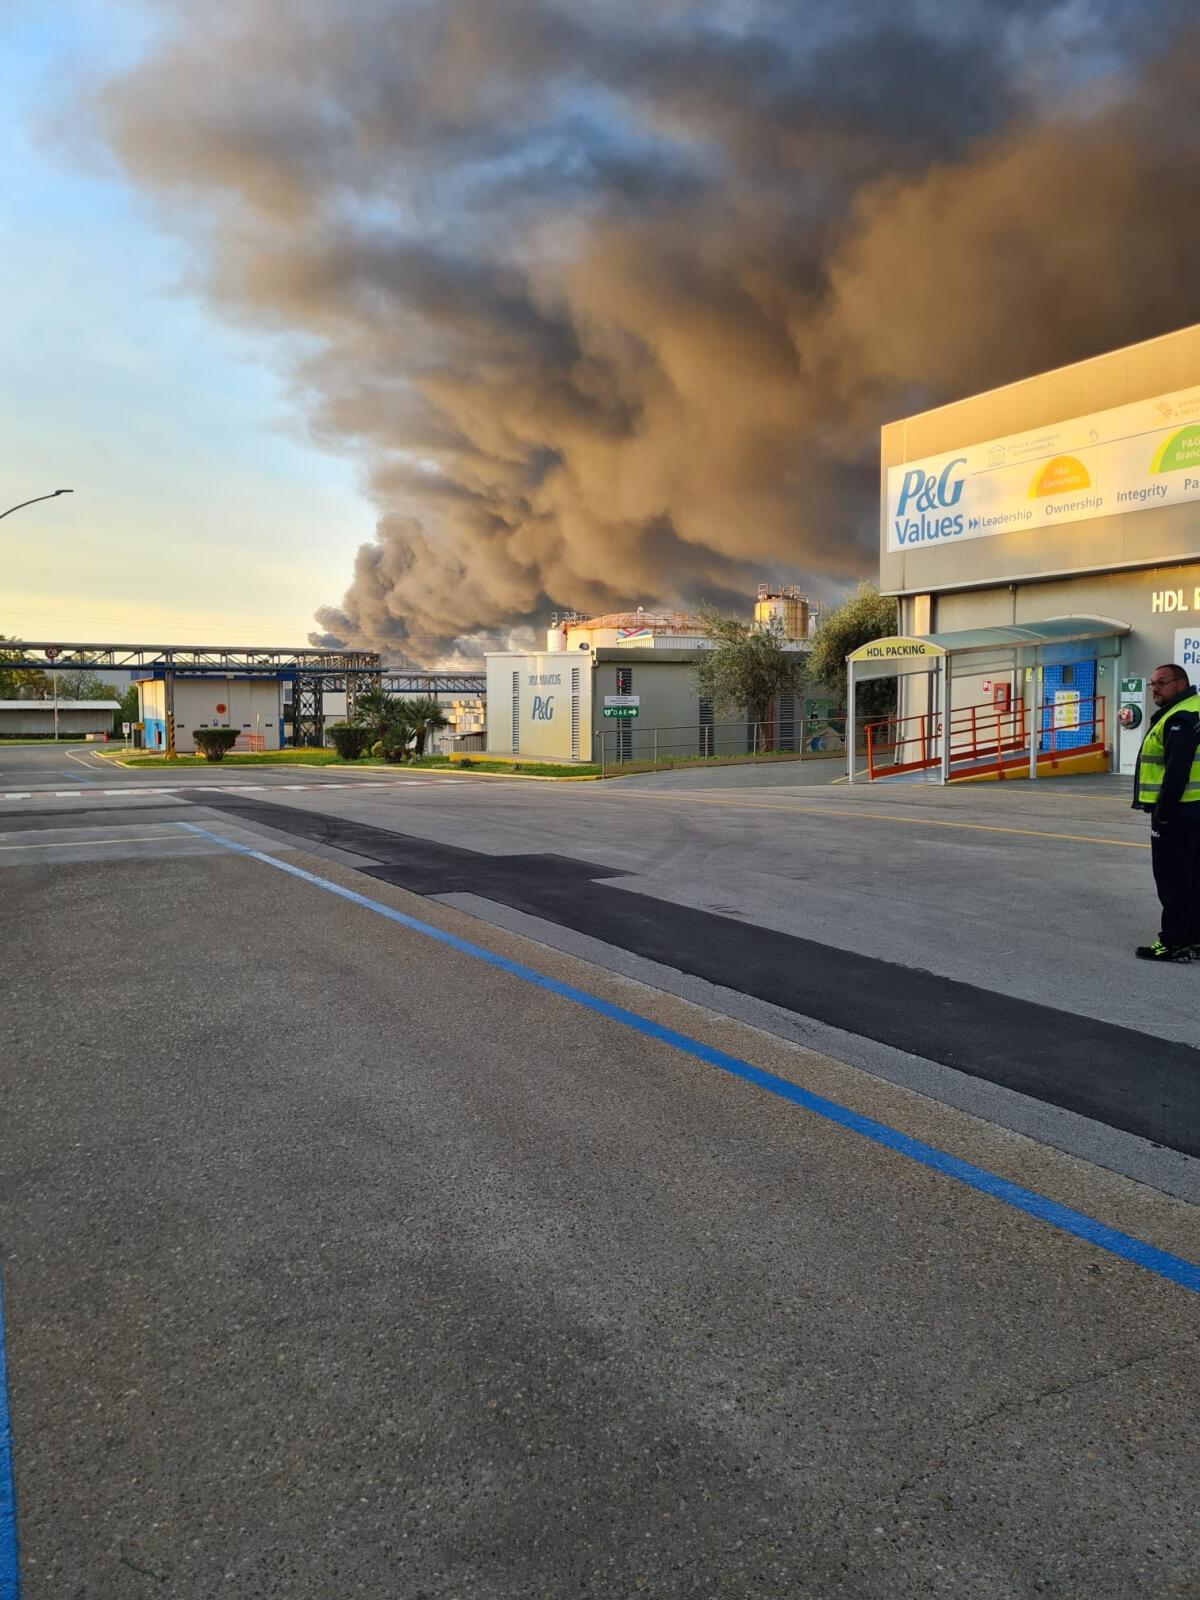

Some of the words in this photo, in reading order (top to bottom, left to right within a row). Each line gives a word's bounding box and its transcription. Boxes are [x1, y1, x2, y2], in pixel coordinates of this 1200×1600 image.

[896, 458, 967, 517] P&G
[982, 509, 1032, 527] Leadership
[1045, 496, 1103, 515] Ownership
[1117, 484, 1168, 503] Integrity
[1184, 478, 1200, 490] Pa
[895, 514, 964, 544] Values
[1152, 589, 1188, 613] HDL
[867, 648, 884, 656] HDL
[886, 645, 925, 656] PACKING
[532, 696, 554, 720] P&G
